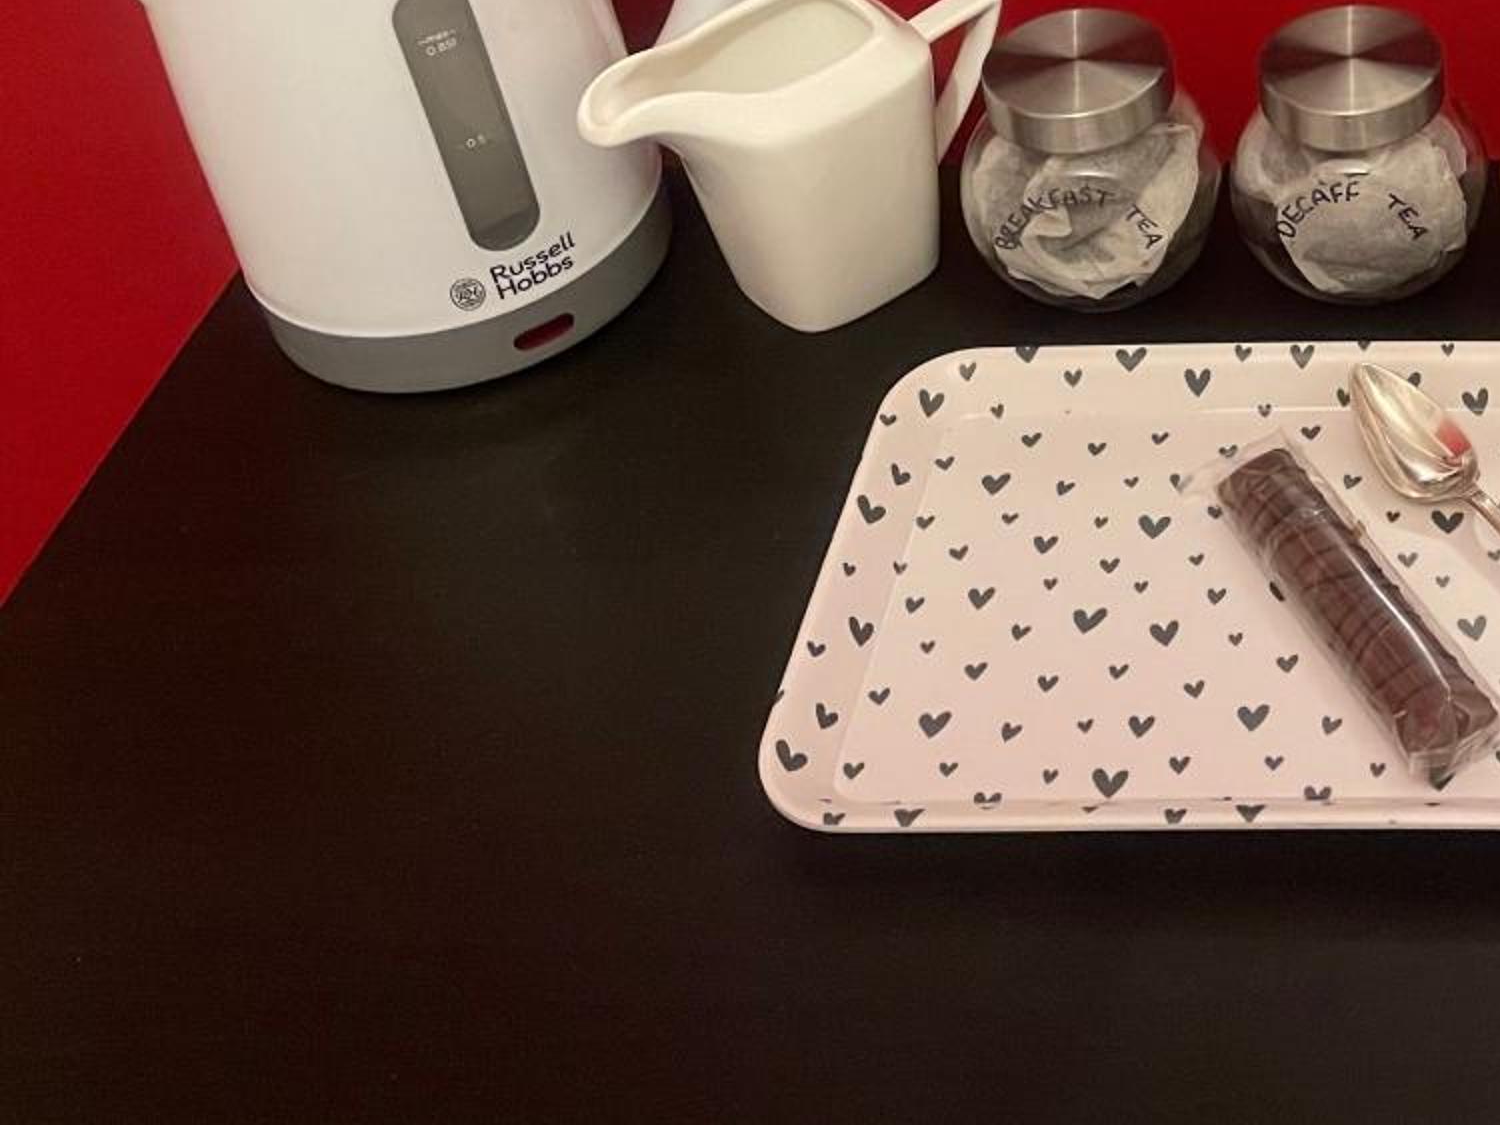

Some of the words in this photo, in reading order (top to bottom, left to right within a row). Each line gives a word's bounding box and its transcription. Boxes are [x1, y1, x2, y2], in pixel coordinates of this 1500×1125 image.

[994, 186, 1117, 251] BREAKFAST
[1124, 203, 1165, 251] TEA
[1275, 179, 1361, 239] DECAFF
[1386, 192, 1430, 242] TEA
[489, 231, 575, 283] Russell
[496, 255, 573, 300] Hobbs
